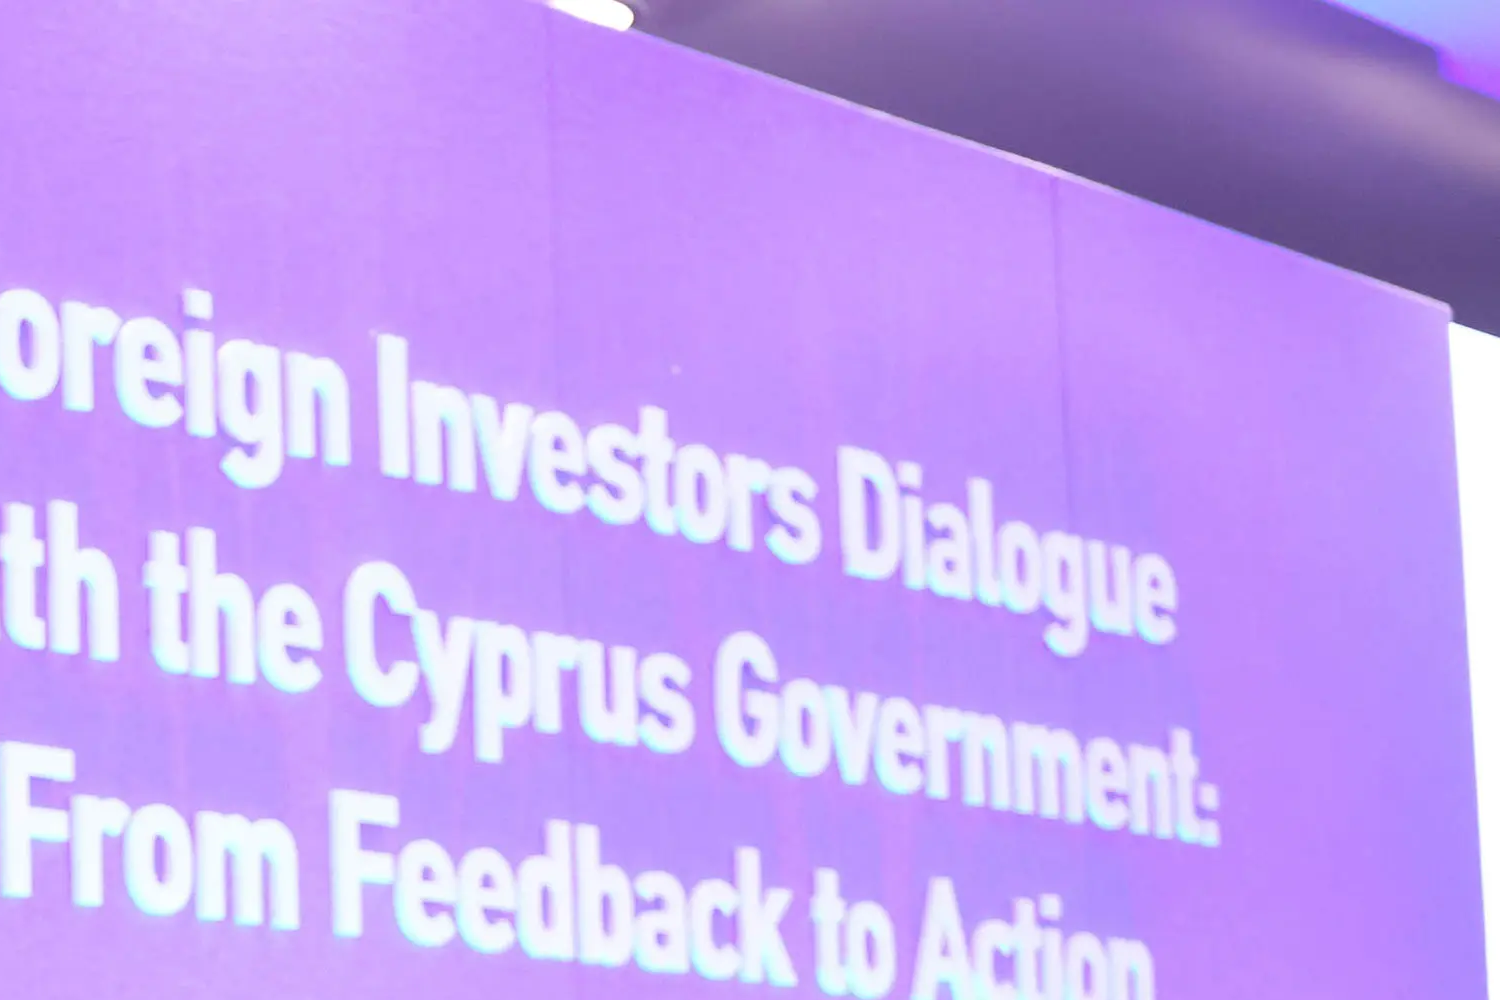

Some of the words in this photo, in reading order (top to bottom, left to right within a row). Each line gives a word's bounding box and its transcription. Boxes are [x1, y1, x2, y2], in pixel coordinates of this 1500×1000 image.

[376, 333, 822, 565] Investors
[837, 446, 1178, 657] Dialogue
[143, 526, 324, 695] the
[344, 560, 696, 763] Cyprus
[714, 631, 1221, 848] Government:
[329, 789, 799, 988] Feedback
[810, 867, 897, 1000] to
